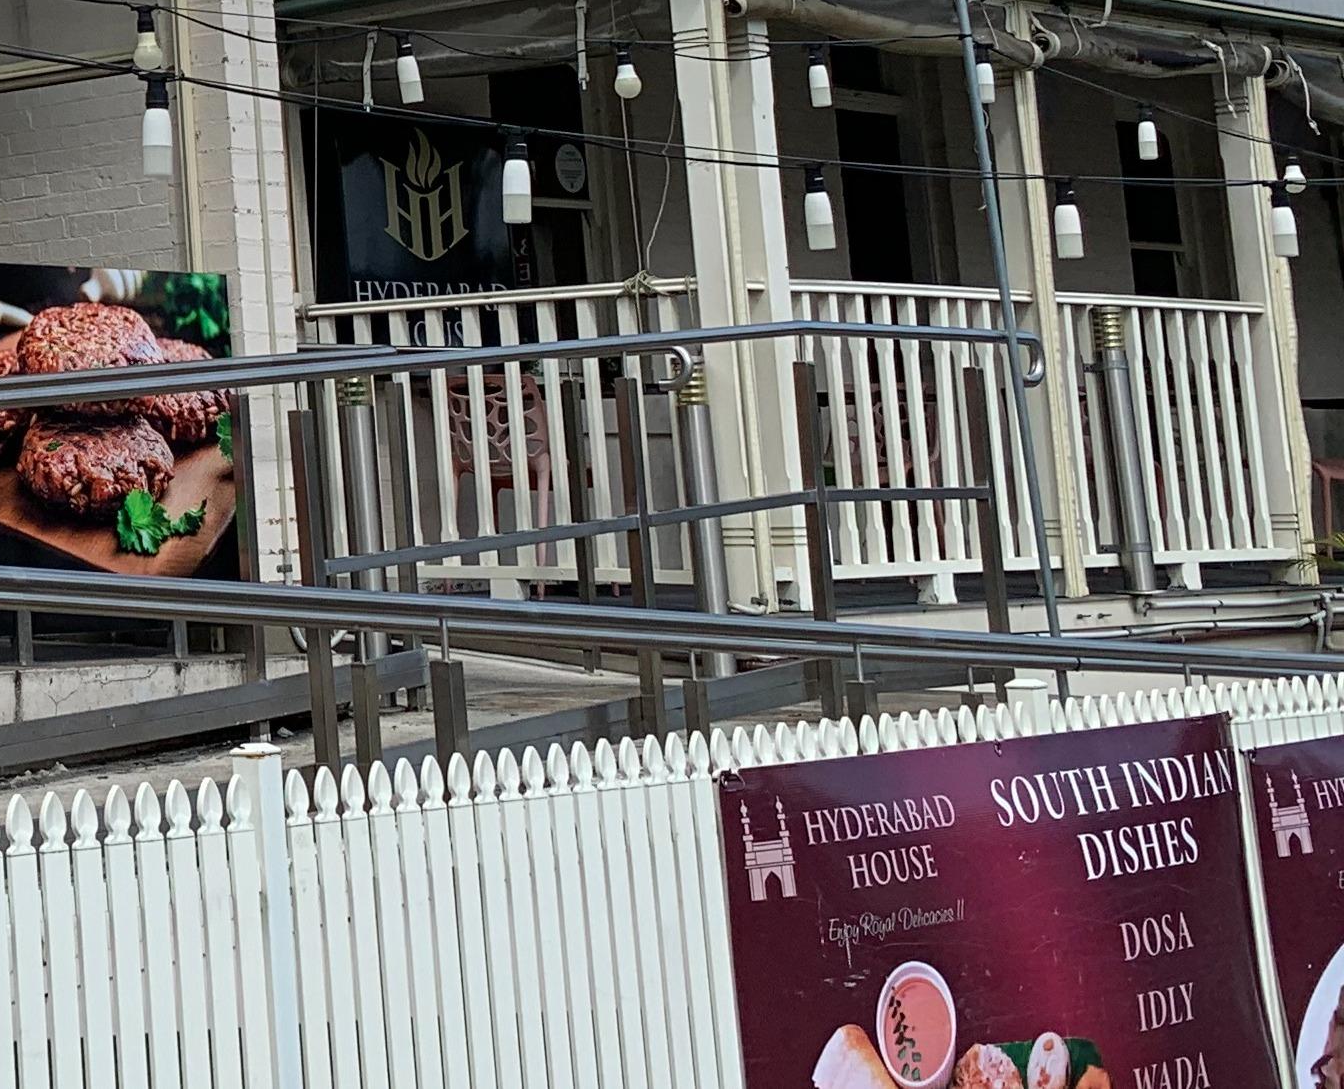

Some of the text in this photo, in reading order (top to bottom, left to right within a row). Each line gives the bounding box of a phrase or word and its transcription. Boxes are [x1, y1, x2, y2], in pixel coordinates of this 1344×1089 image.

[990, 748, 1233, 827] SOUTH INDIAN
[803, 794, 955, 846] HYDERABAD
[847, 844, 938, 889] HOUSE
[1077, 816, 1199, 881] DISHES
[828, 918, 860, 947] Enjoy
[860, 912, 895, 941] Royal
[898, 907, 954, 931] Delicacies
[1119, 911, 1194, 961] DOSA
[1137, 982, 1194, 1032] IDLY
[1133, 1052, 1211, 1089] WADA
